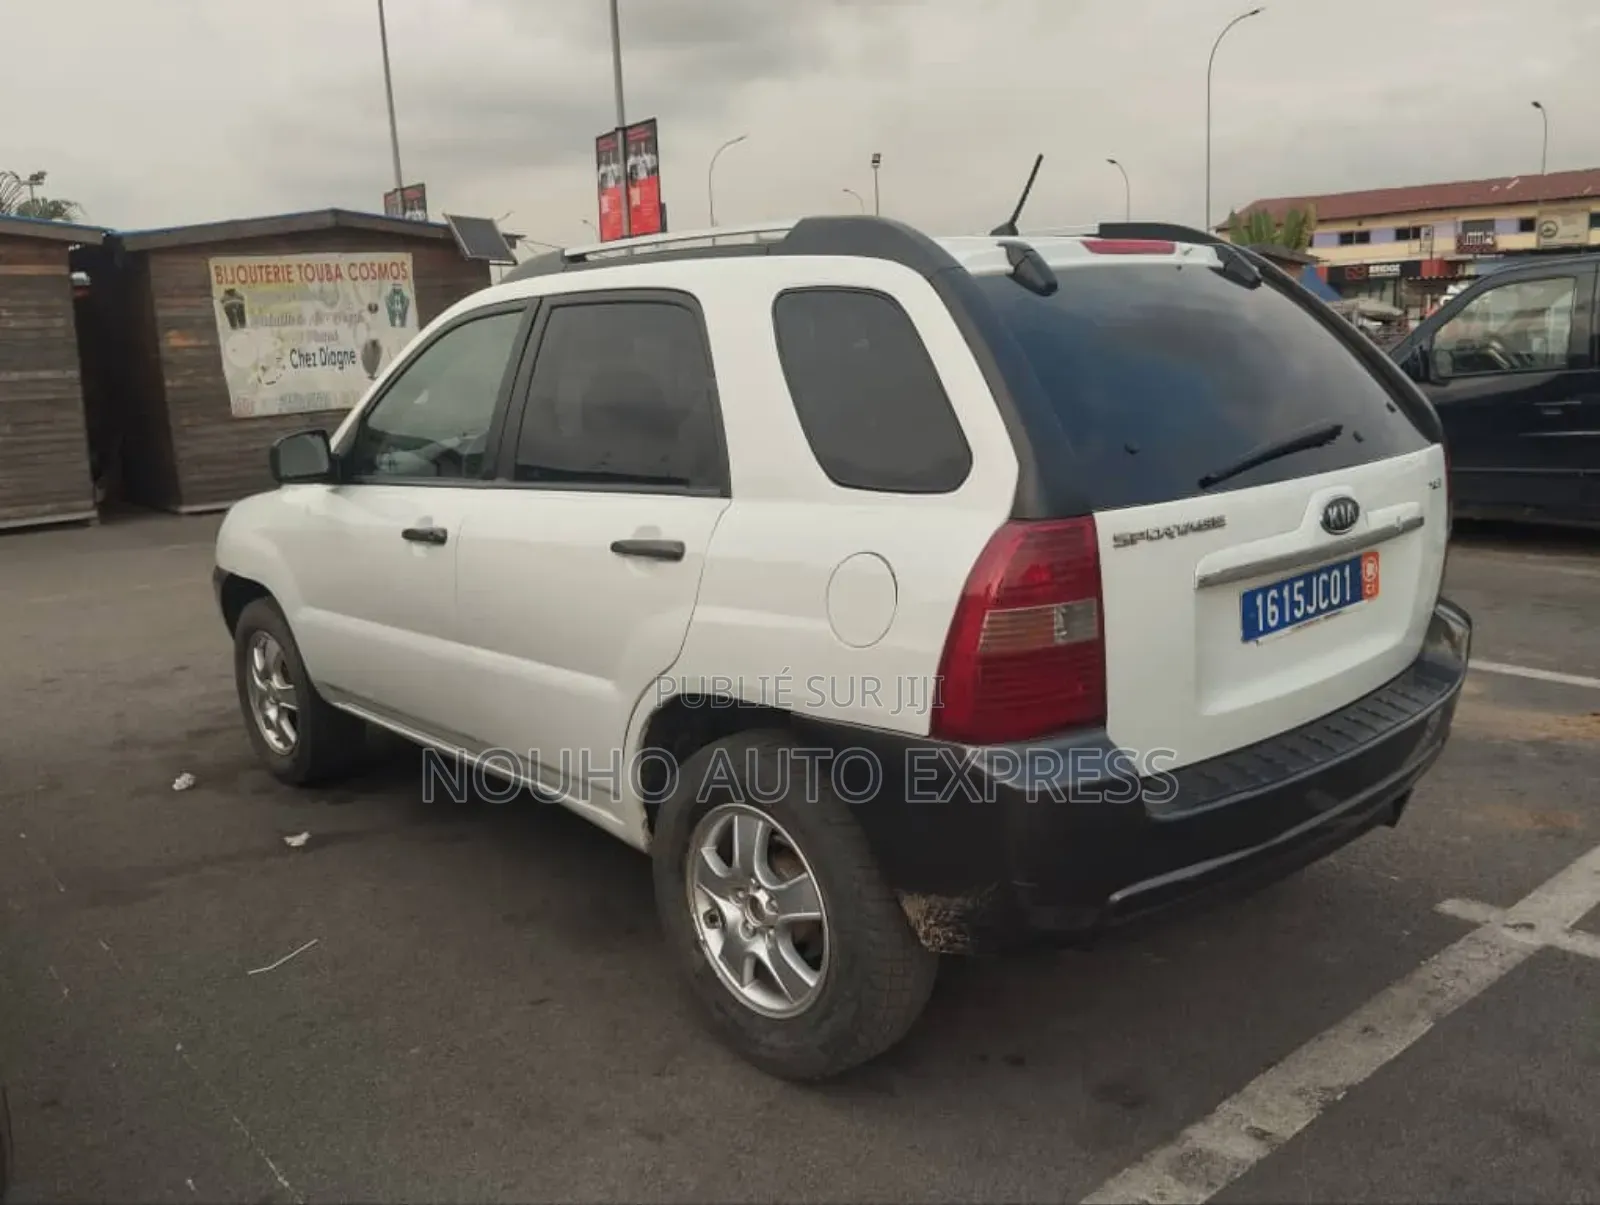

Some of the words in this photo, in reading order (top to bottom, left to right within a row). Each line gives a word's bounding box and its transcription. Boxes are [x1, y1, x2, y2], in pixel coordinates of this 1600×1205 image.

[214, 264, 293, 285] BIJOUTERIE
[298, 263, 343, 282] TOUBA
[349, 261, 409, 281] COSMOS
[289, 348, 317, 369] Chez
[319, 346, 357, 370] Diagne
[1328, 500, 1357, 532] KIA
[1255, 563, 1351, 632] 1615JC01
